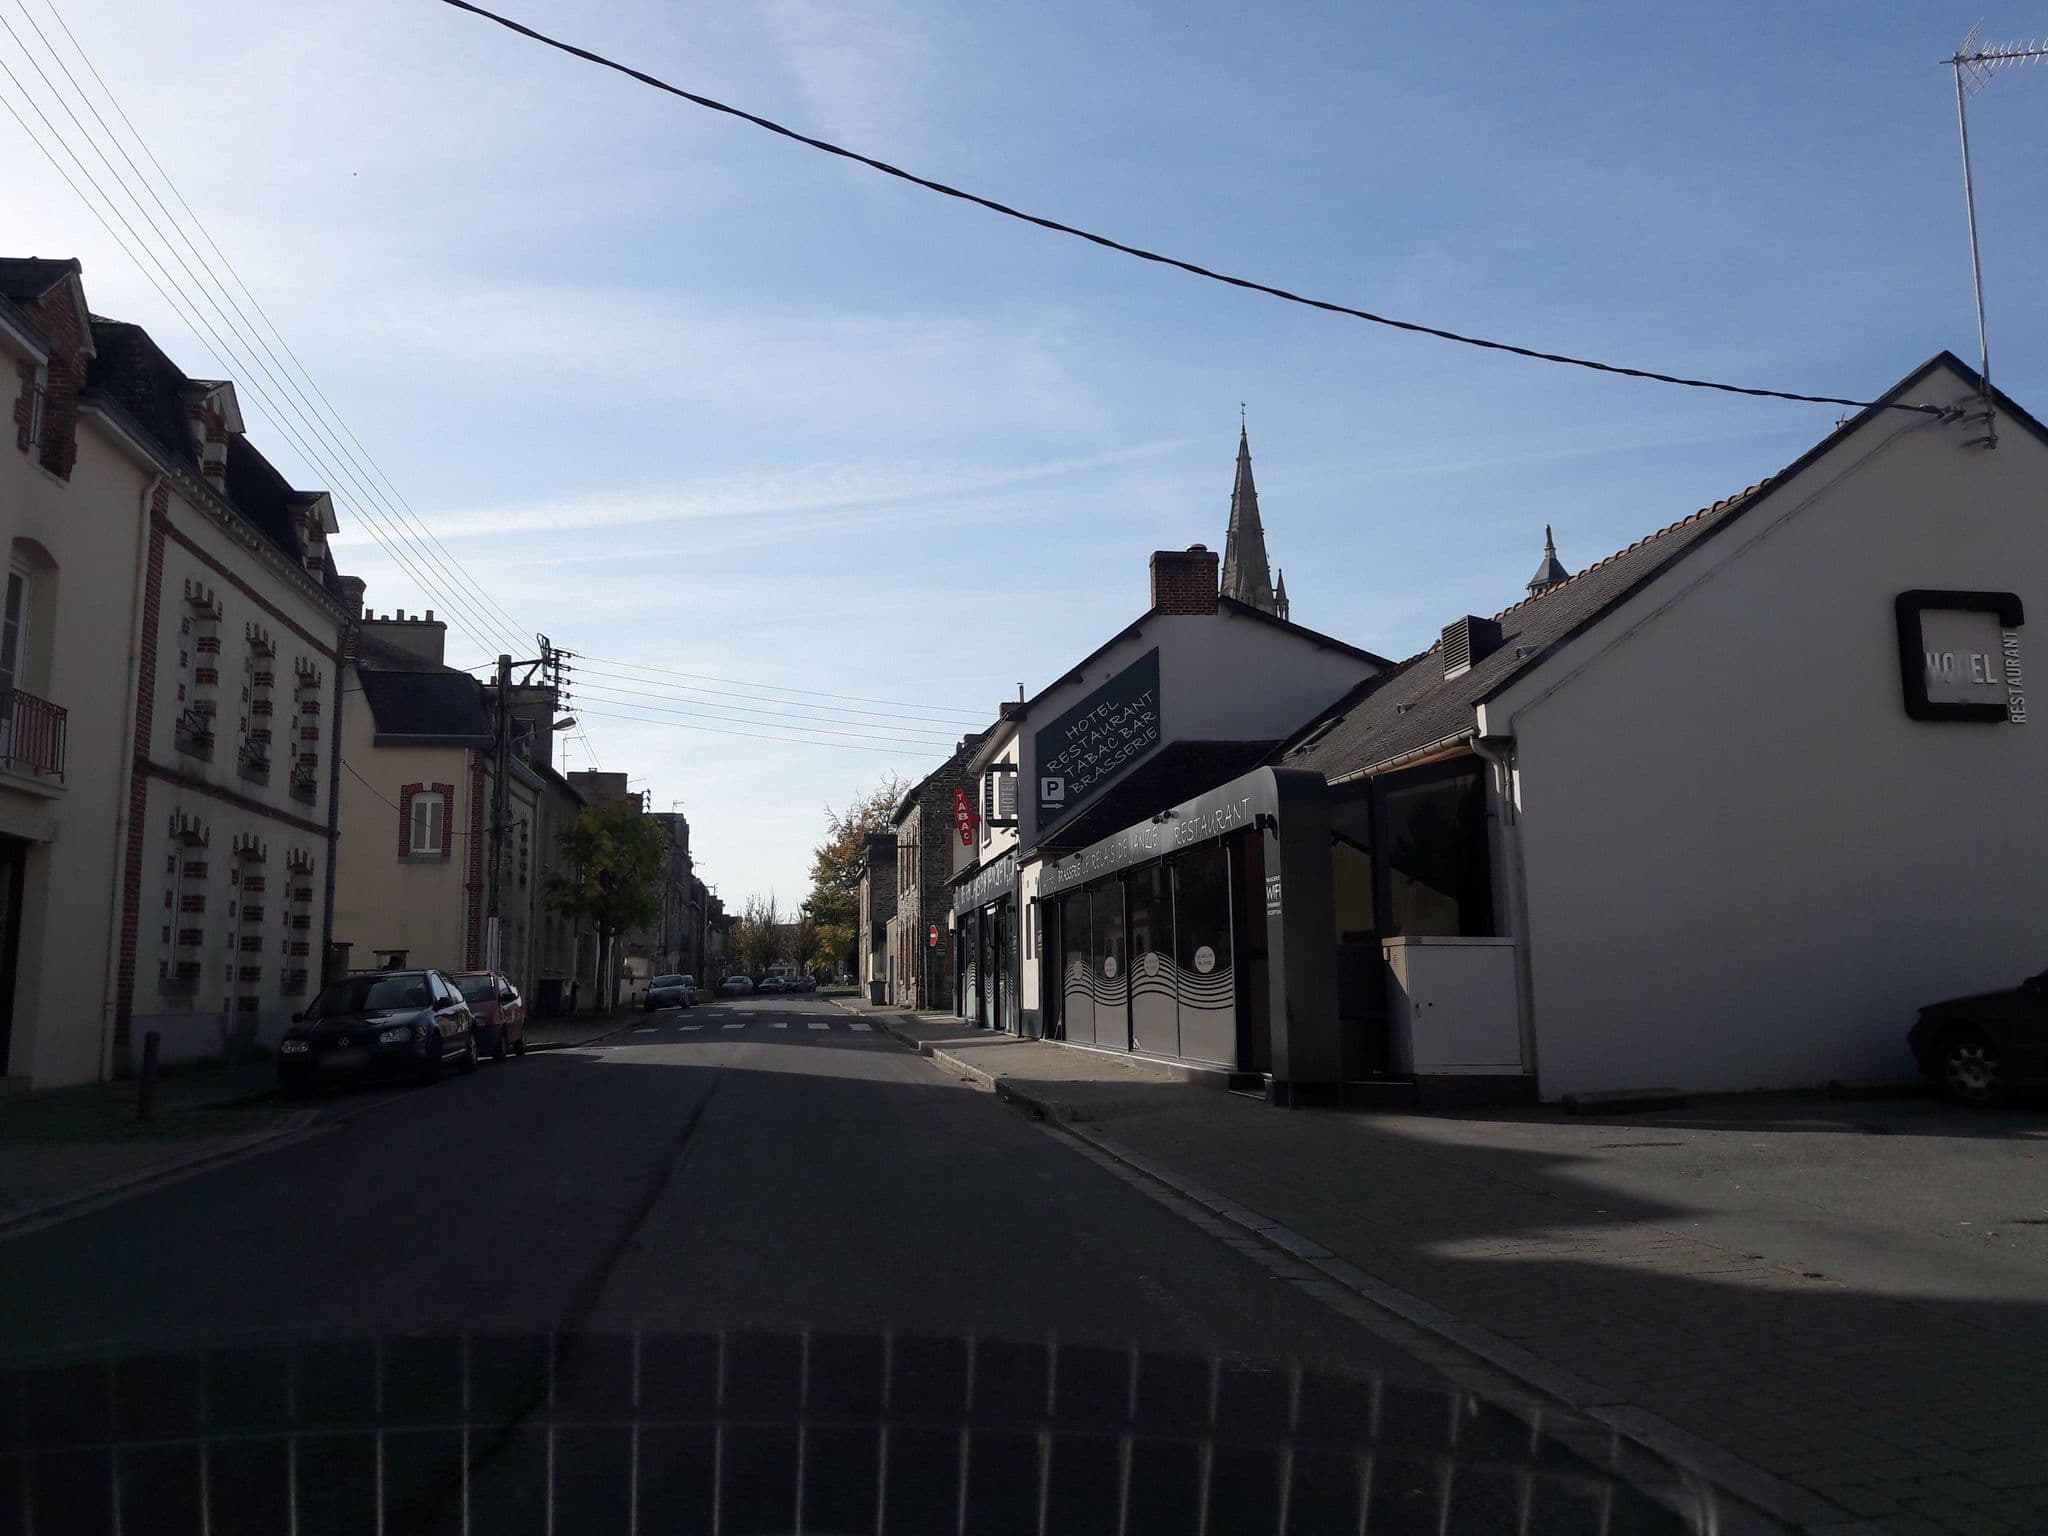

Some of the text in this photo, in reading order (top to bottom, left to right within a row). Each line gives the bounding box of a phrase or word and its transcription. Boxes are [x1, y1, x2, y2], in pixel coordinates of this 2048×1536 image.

[1925, 651, 1999, 684] HOEL
[2001, 630, 2027, 724] RESTAURANT
[1046, 689, 1153, 773] RESTAURANT
[1064, 711, 1157, 778] TABAC BAR
[1065, 701, 1120, 740] HOTEL
[1069, 726, 1158, 794] BRASSERIE
[1001, 781, 1015, 812] HOTEL
[1046, 781, 1059, 797] P
[956, 794, 970, 840] TABAC
[1118, 838, 1128, 859] DE
[1174, 797, 1251, 845] RESTAURANT
